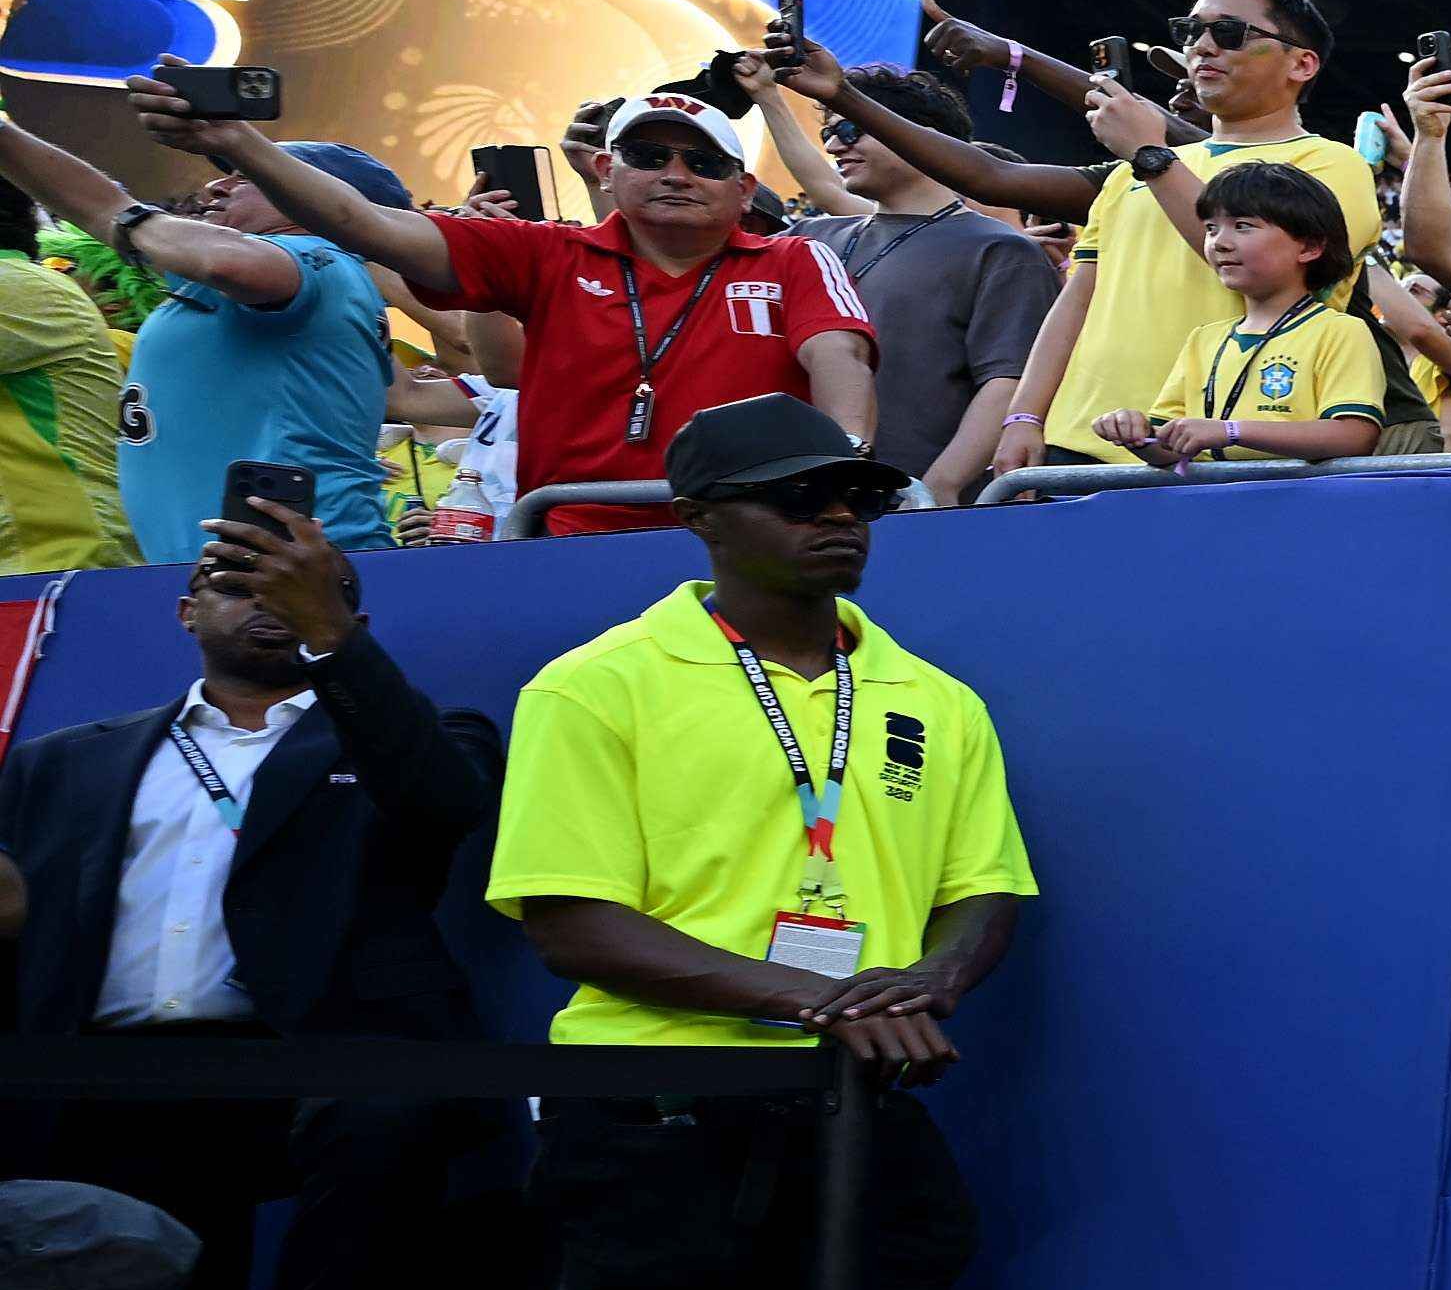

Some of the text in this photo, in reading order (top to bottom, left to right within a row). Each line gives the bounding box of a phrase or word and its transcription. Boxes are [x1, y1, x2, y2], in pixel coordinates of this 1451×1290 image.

[732, 284, 778, 297] FPF
[1257, 404, 1293, 413] BRASIL
[835, 653, 849, 671] FIFA
[755, 685, 777, 708] CUP
[837, 669, 852, 707] WORLD
[767, 707, 796, 749] WORLD
[836, 708, 851, 730] CUP
[788, 747, 806, 772] FIFA
